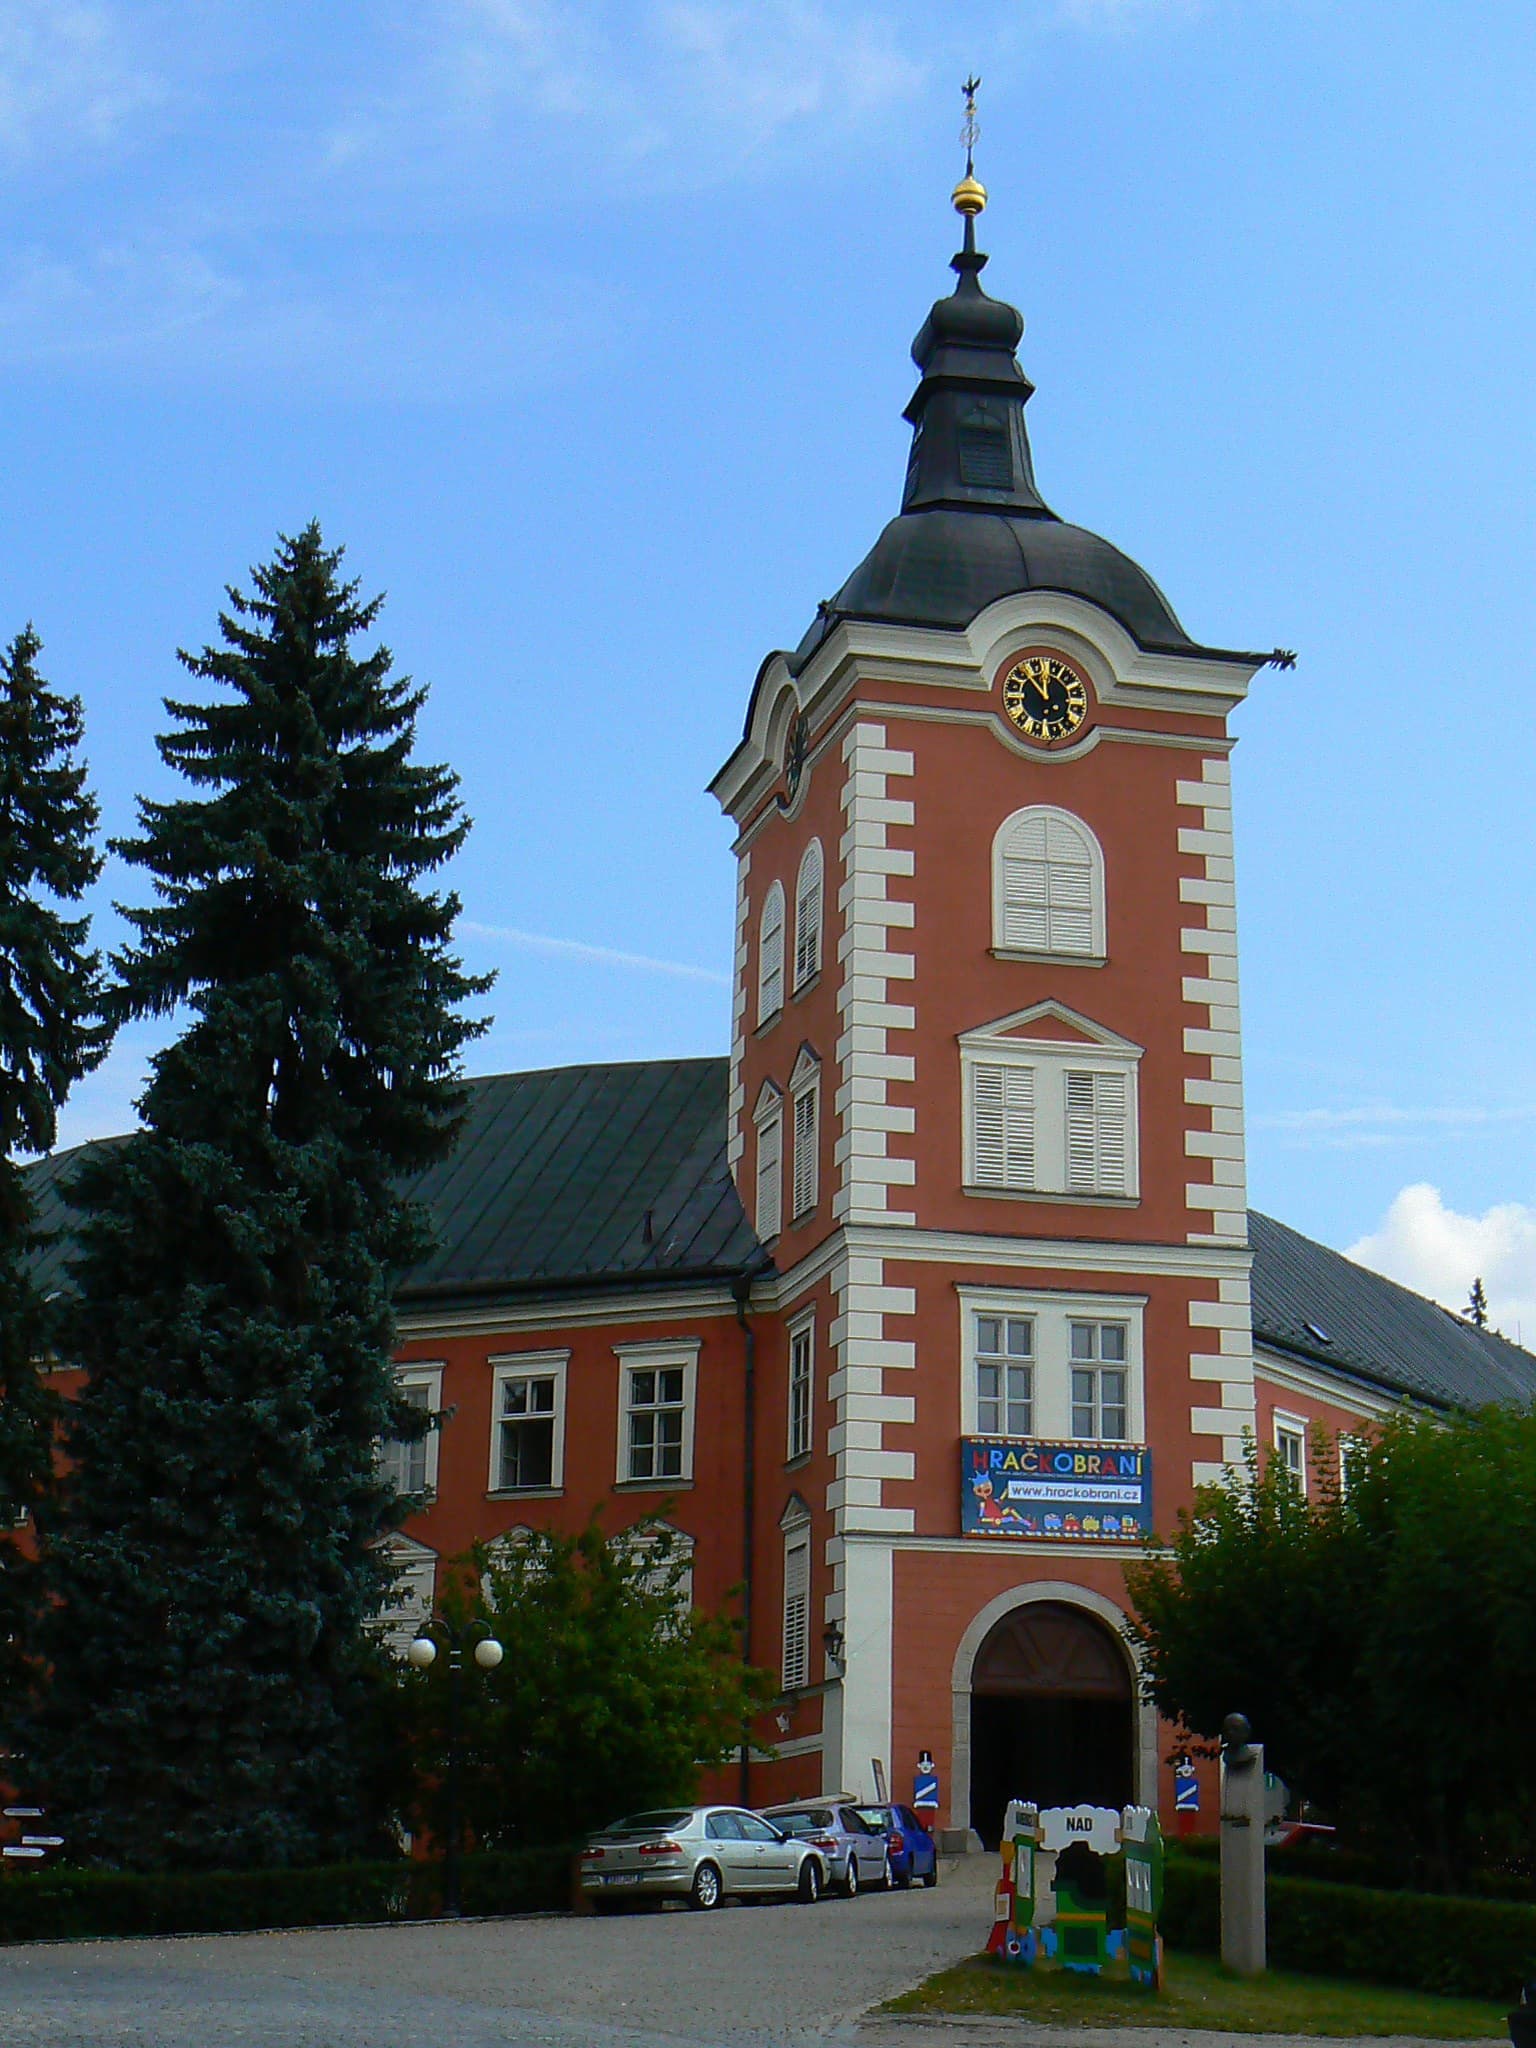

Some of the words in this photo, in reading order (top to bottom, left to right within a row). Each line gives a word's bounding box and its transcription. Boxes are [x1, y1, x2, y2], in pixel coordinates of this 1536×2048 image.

[973, 1448, 1143, 1475] HRAČKOBRANÍ
[1011, 1486, 1139, 1500] www.hrackobrani.cz
[1066, 1816, 1093, 1832] NAD
